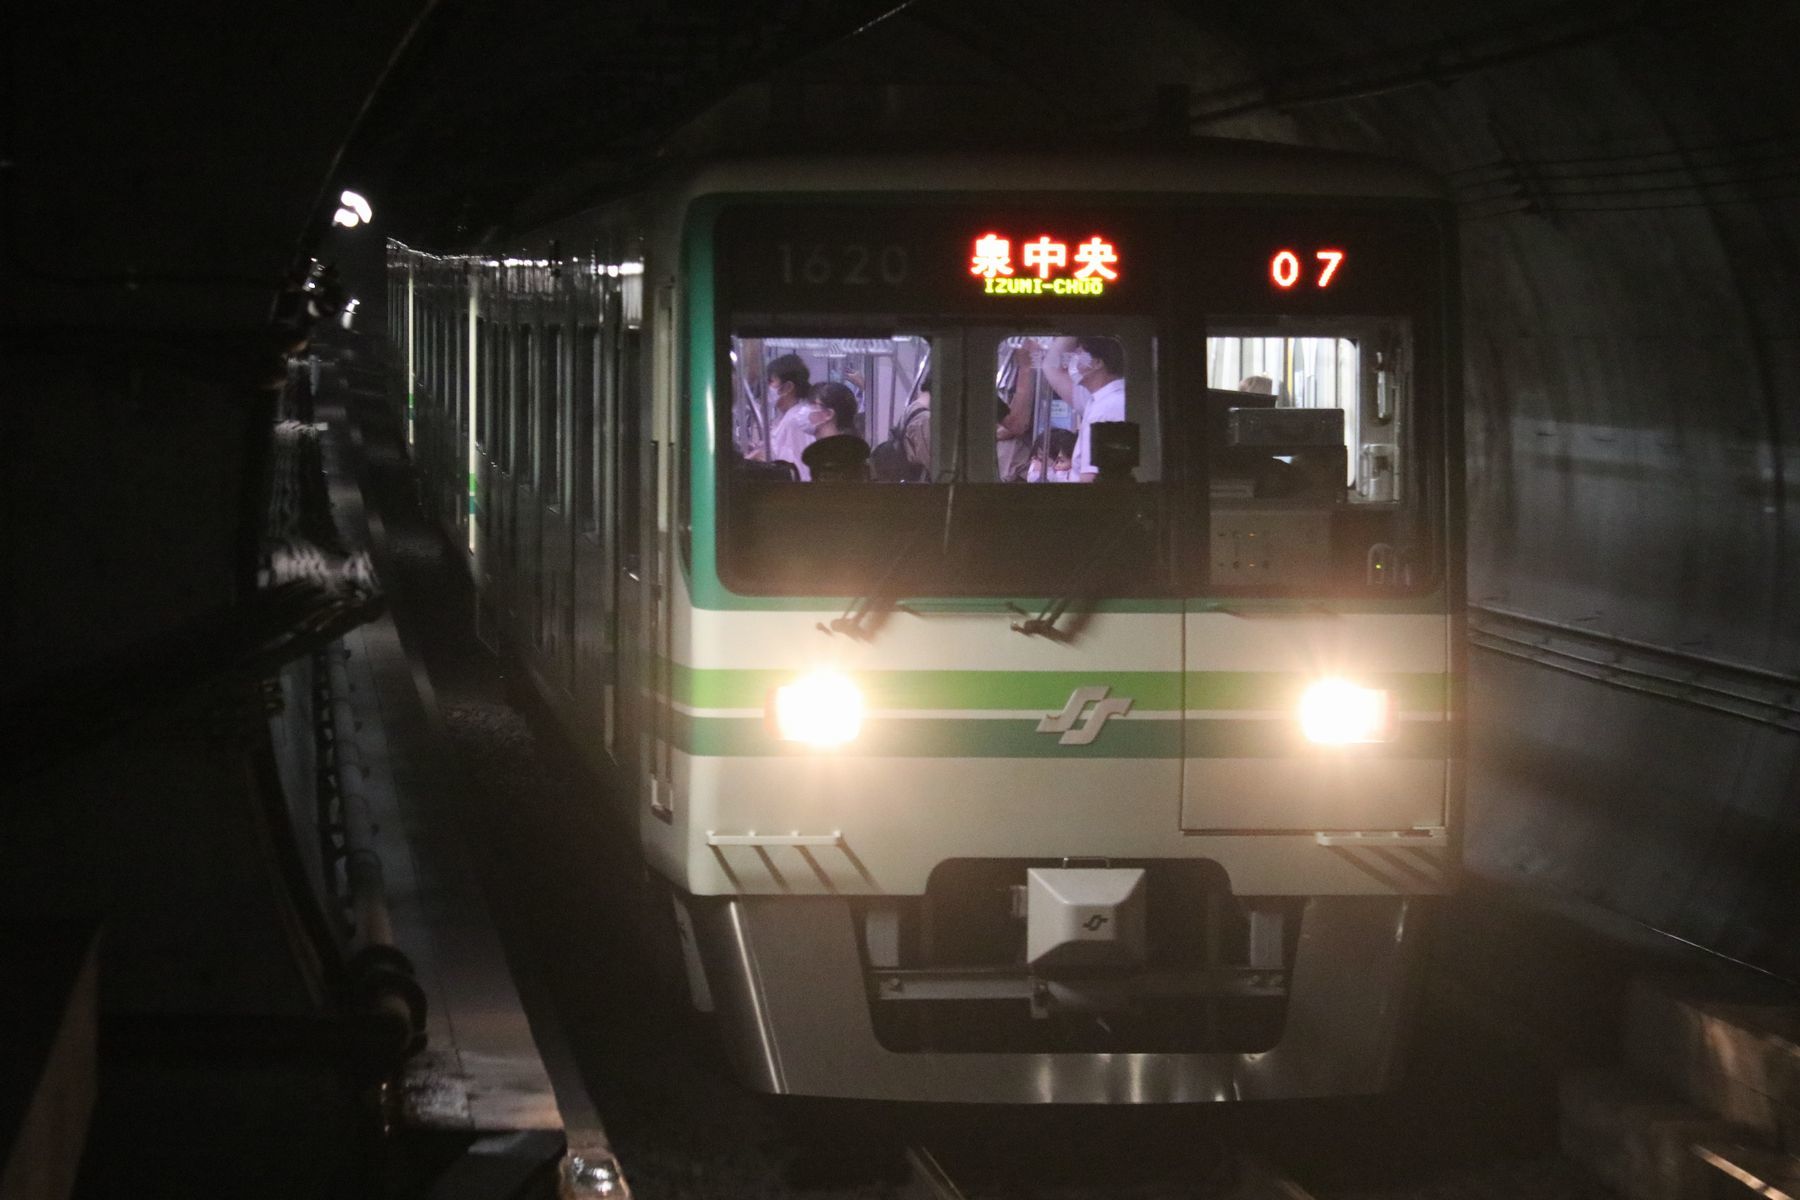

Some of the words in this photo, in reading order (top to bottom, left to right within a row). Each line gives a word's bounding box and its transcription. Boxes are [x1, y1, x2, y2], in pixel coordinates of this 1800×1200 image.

[777, 243, 909, 285] 1620
[970, 233, 1119, 280] 泉中央
[1272, 250, 1344, 288] 07
